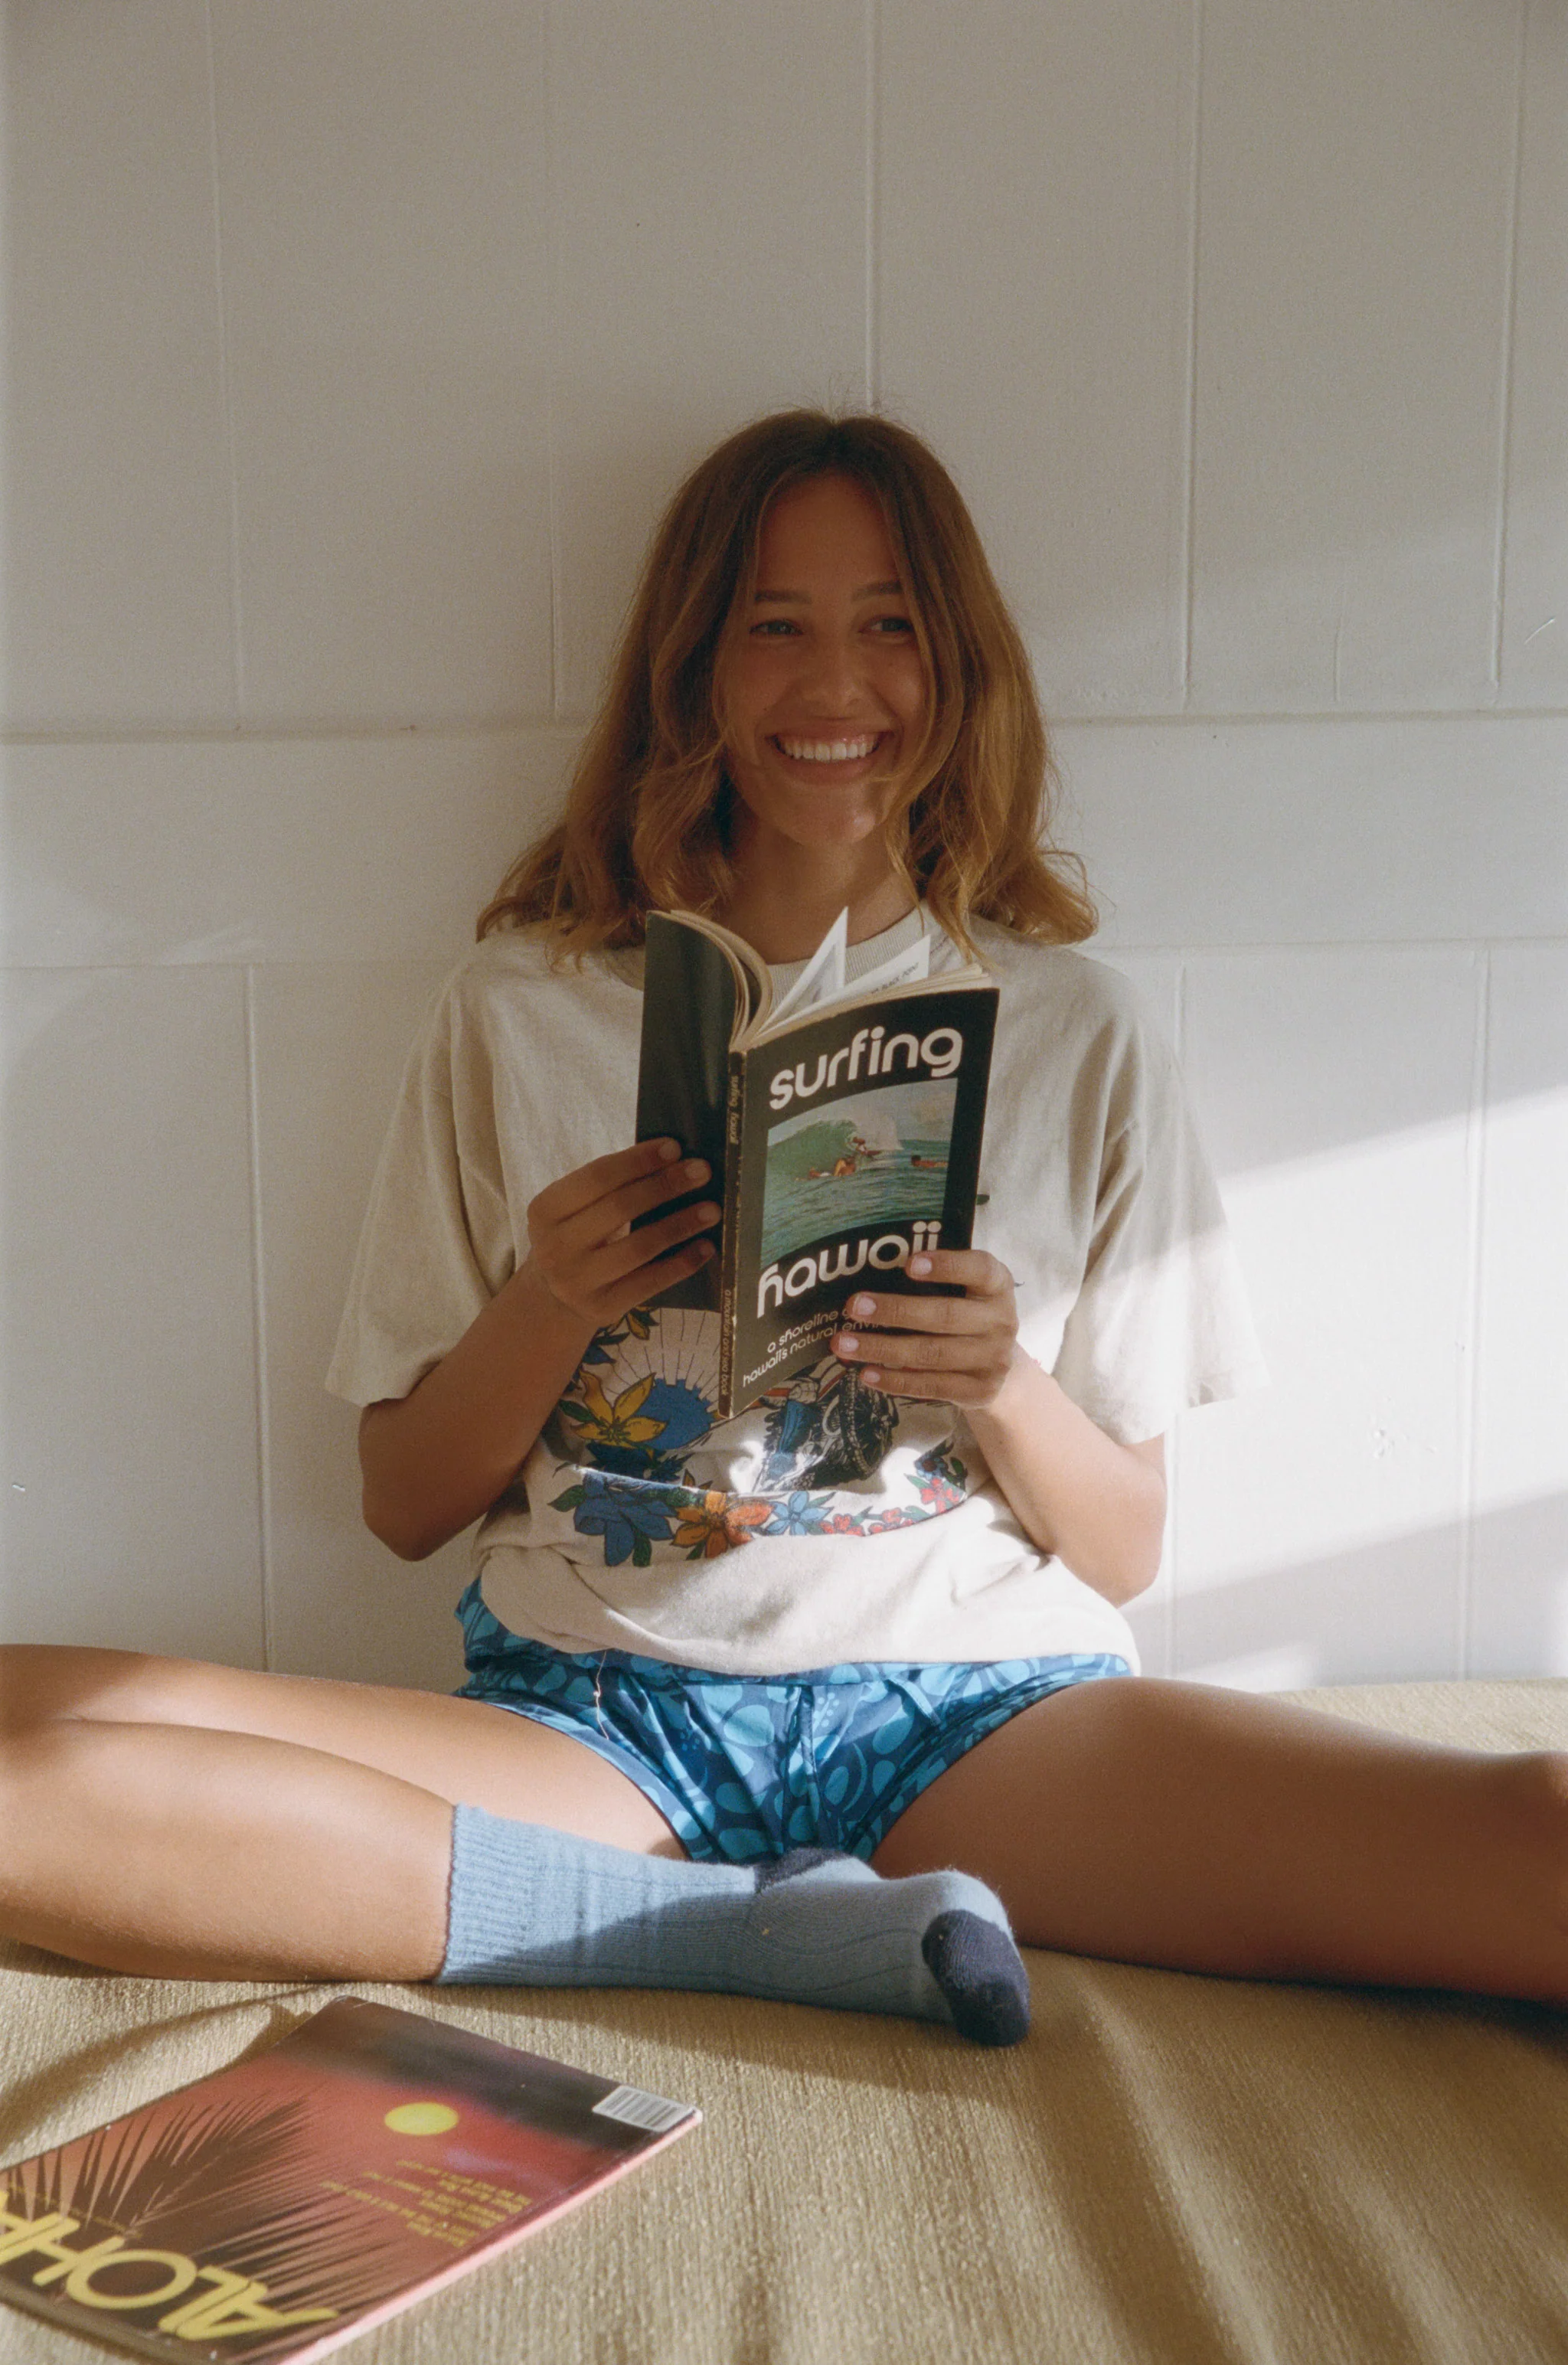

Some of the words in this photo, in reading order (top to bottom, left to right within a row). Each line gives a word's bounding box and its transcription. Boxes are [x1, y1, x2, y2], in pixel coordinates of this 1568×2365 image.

[769, 1025, 963, 1109] surfing
[756, 1220, 942, 1319] hawaii
[767, 1341, 776, 1353] a
[779, 1310, 839, 1346] shoreline
[790, 1321, 838, 1354] natural
